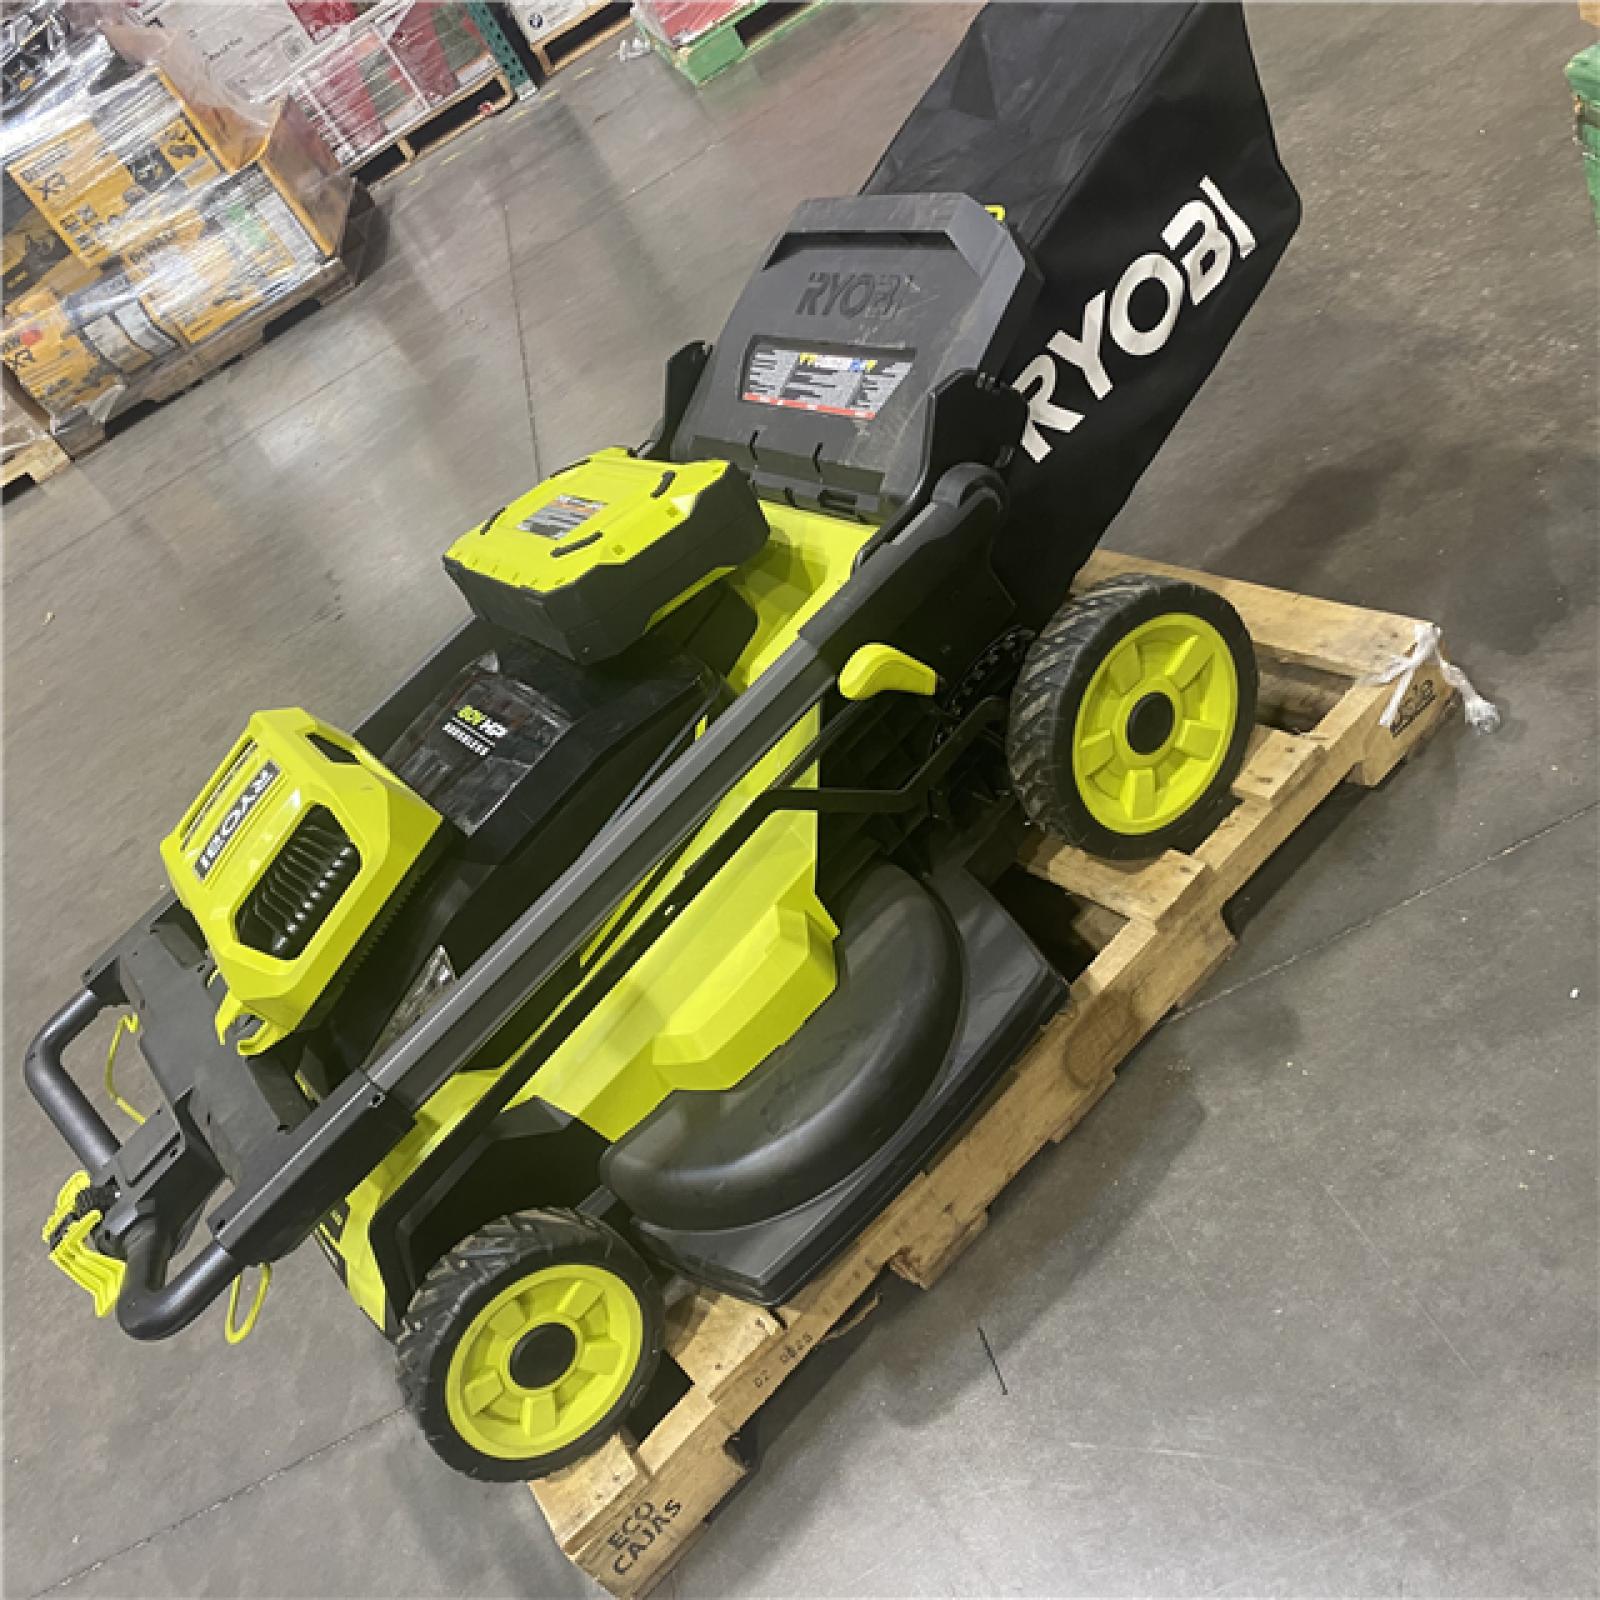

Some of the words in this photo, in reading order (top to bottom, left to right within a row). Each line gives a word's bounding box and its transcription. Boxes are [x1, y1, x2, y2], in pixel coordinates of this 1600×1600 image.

[795, 271, 914, 318] RYOBI
[1011, 175, 1256, 462] RYOBI
[197, 764, 278, 872] RYOBI
[607, 1502, 655, 1551] ECO
[612, 1499, 682, 1576] CAJAS
